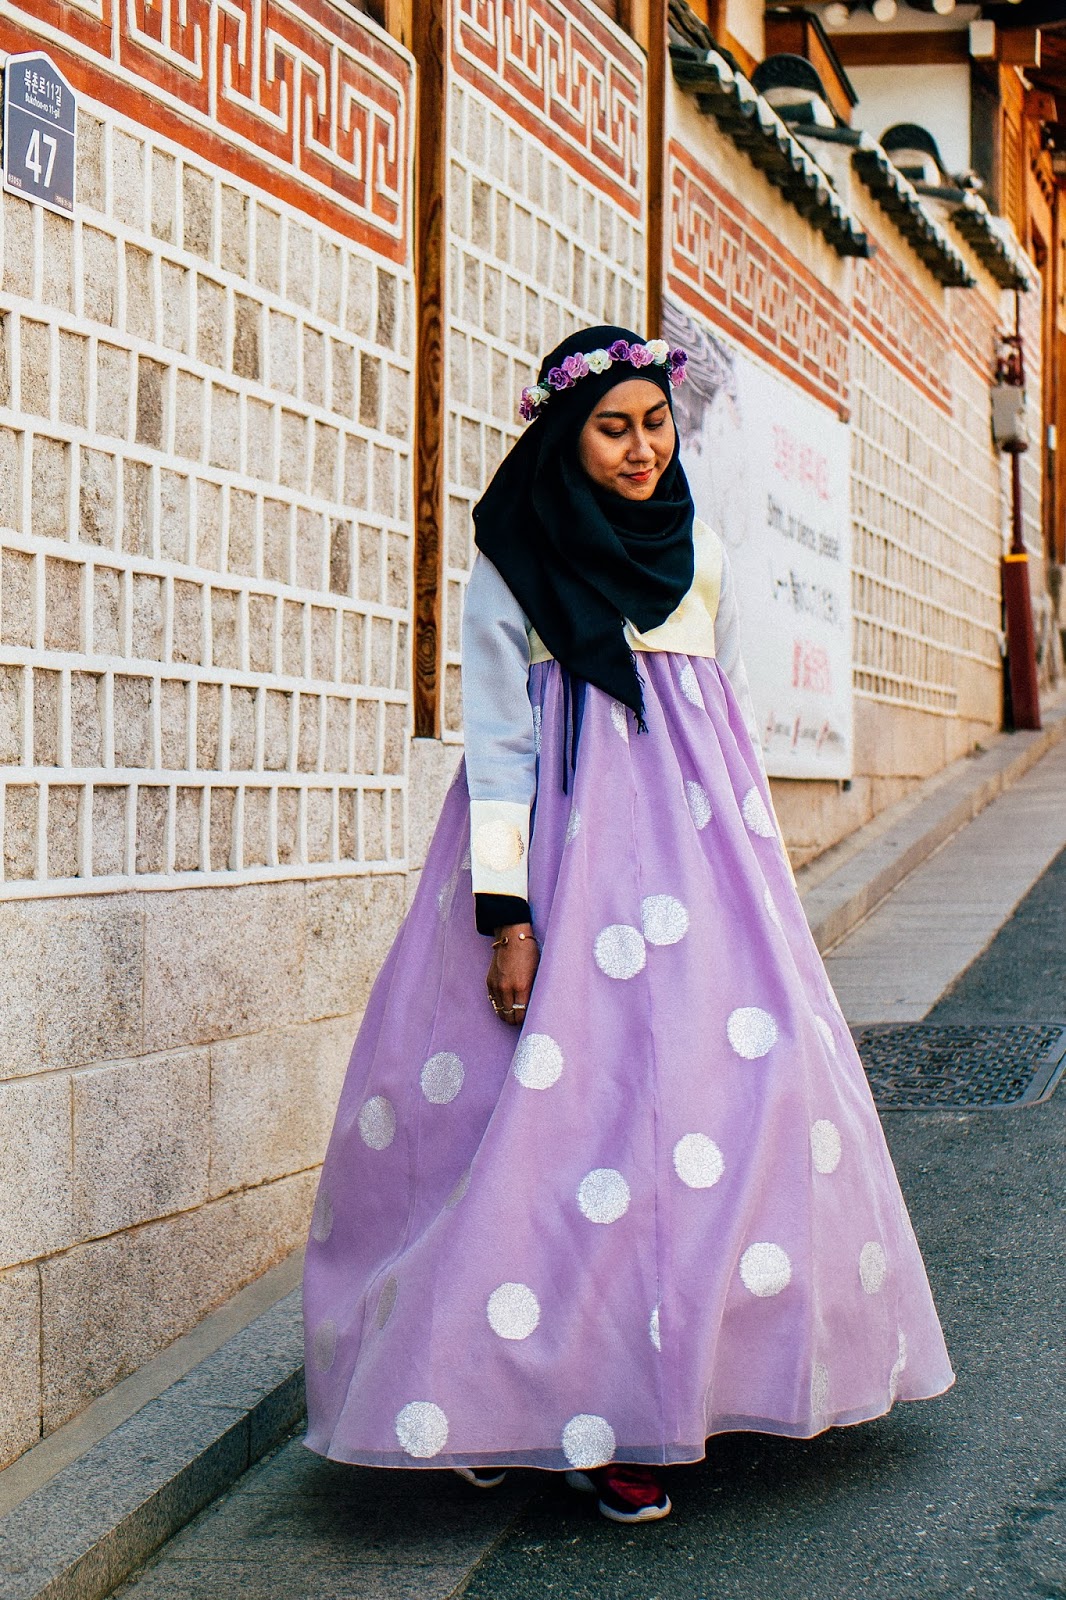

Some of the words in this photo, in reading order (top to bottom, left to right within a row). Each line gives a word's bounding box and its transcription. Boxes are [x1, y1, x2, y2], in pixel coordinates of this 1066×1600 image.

[24, 69, 62, 107] 북촌로11길
[25, 92, 48, 112] Bukchon-ro
[25, 129, 57, 188] 47
